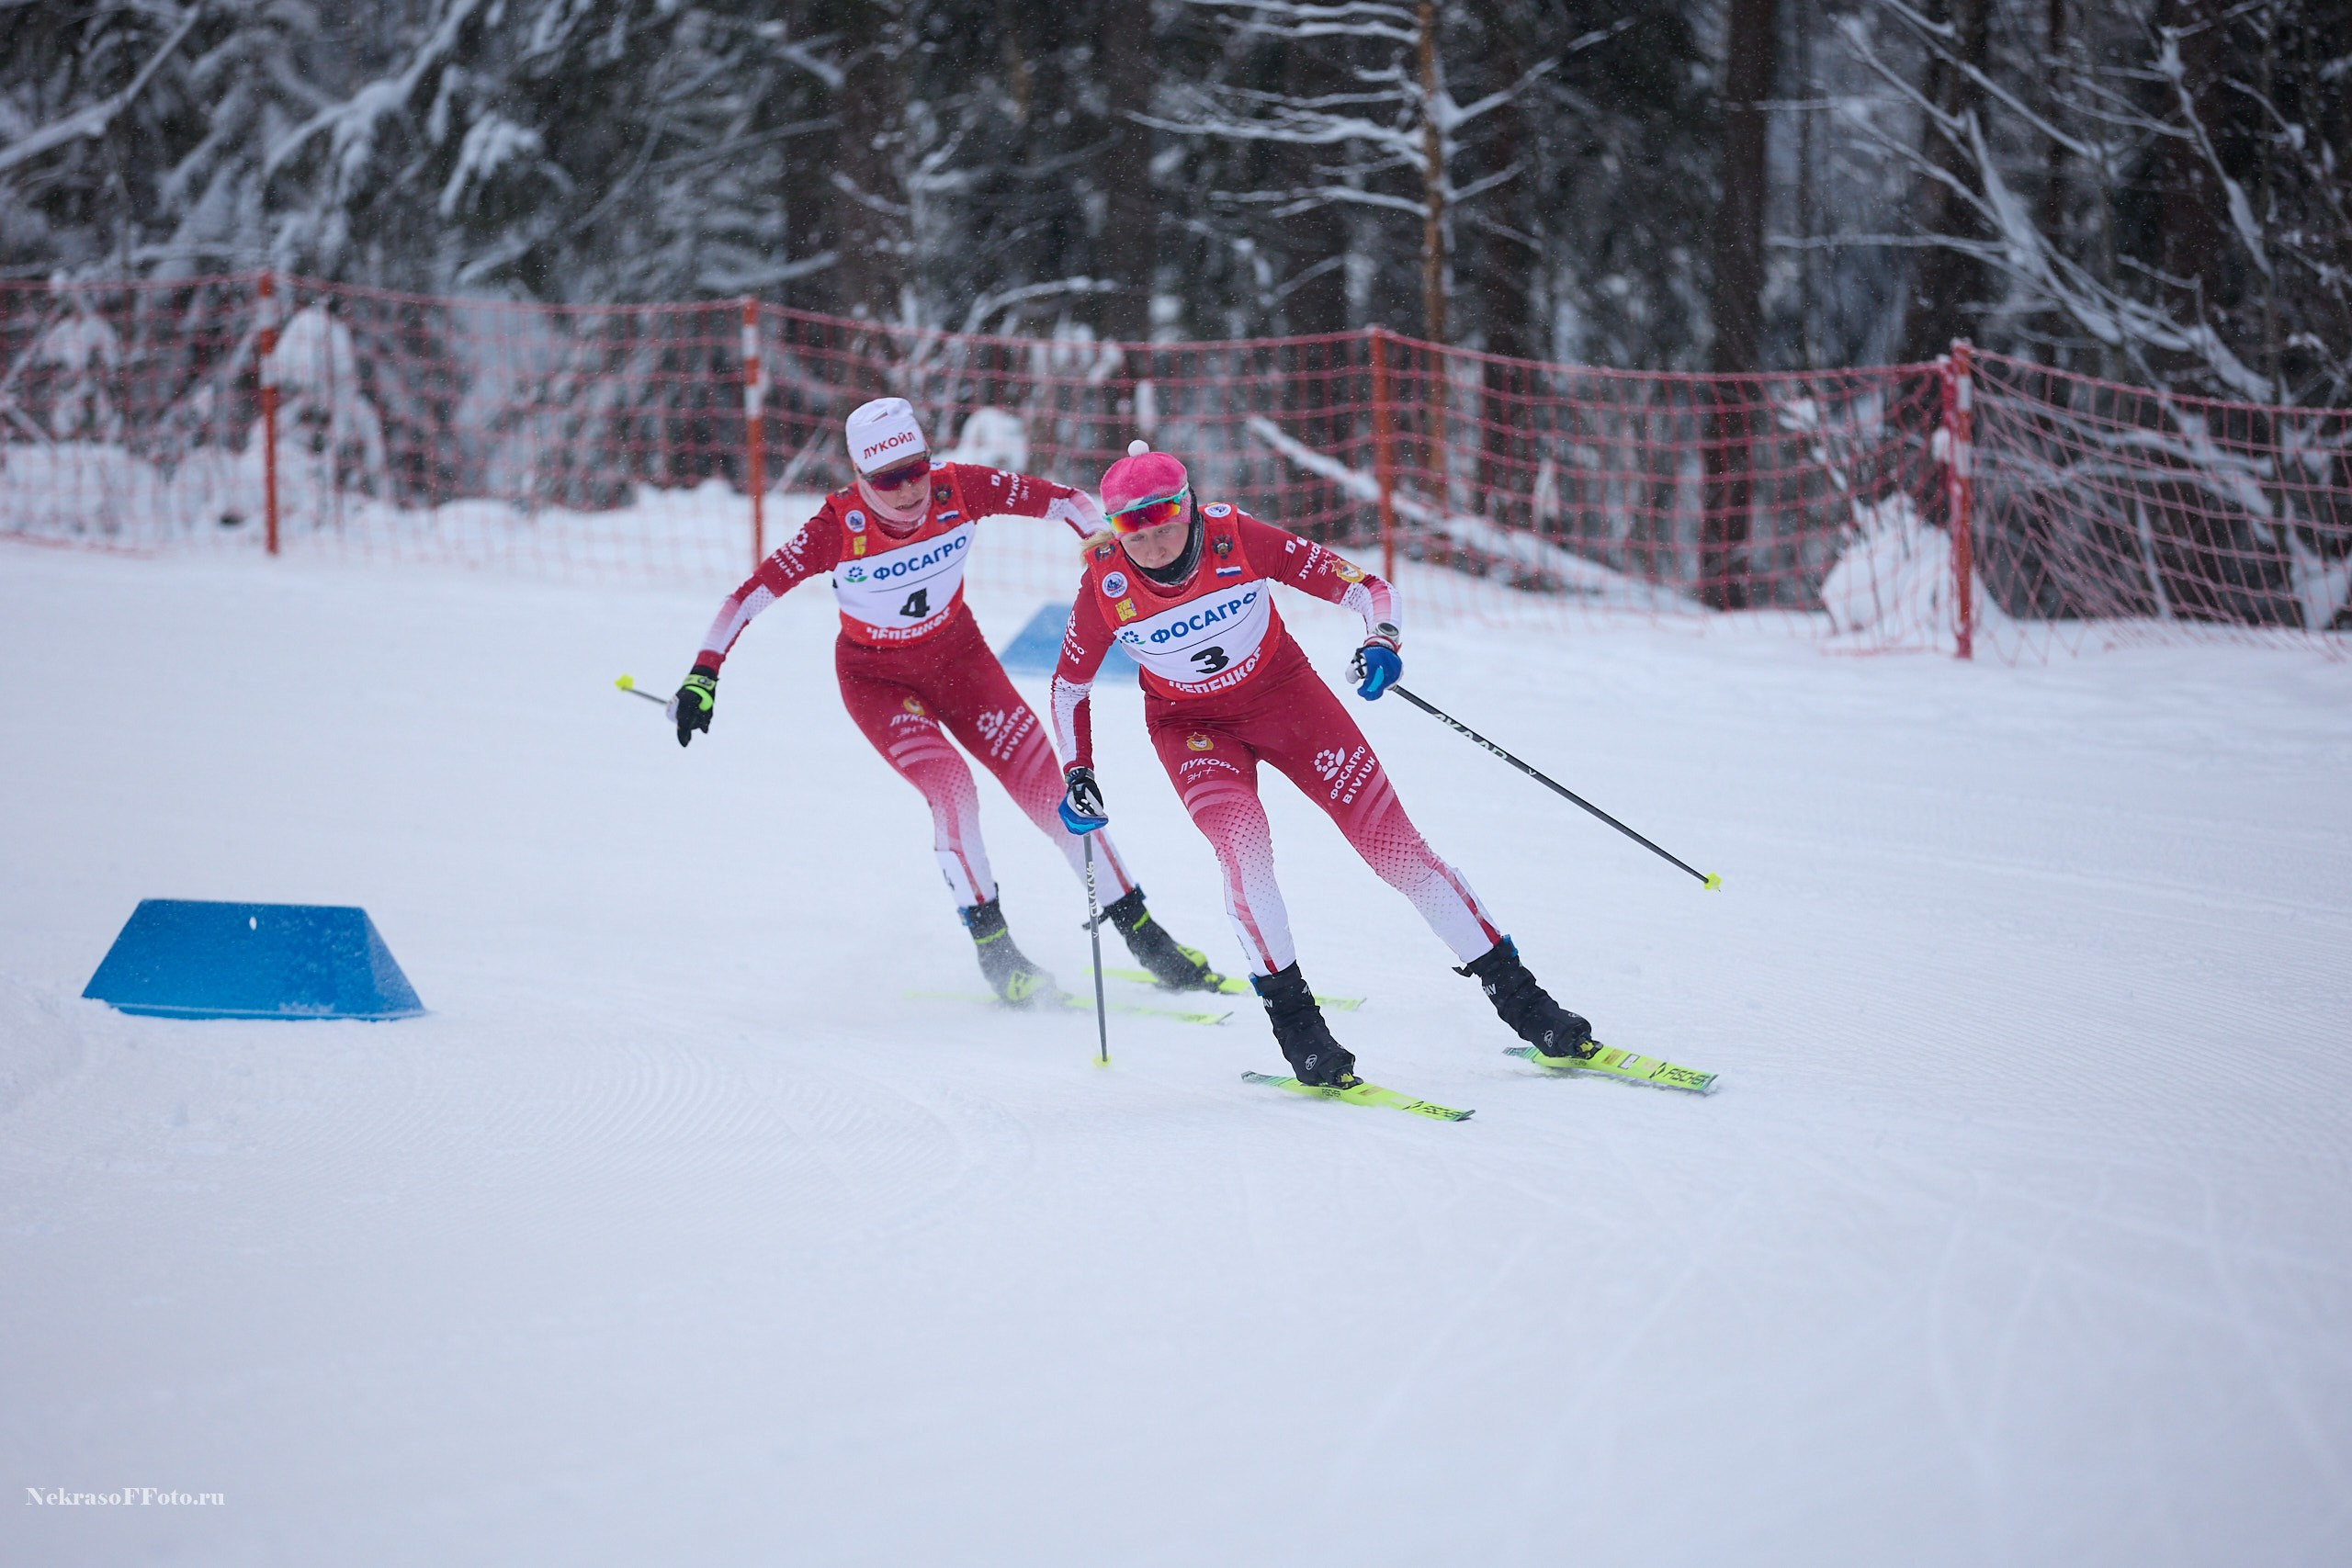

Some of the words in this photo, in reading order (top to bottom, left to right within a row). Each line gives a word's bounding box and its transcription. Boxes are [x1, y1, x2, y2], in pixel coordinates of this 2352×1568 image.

[864, 432, 916, 459] ЛУКОЙЛ
[1006, 472, 1020, 507] ЛУКО
[873, 536, 967, 580] ФОСАГРО
[1298, 541, 1322, 580] ЛУКО
[899, 587, 931, 618] 4
[1150, 591, 1258, 644] ФОСАГРО
[1190, 646, 1230, 674] 3
[1330, 745, 1366, 800] ФОСАГРО
[1664, 1067, 1711, 1087] FISCHER
